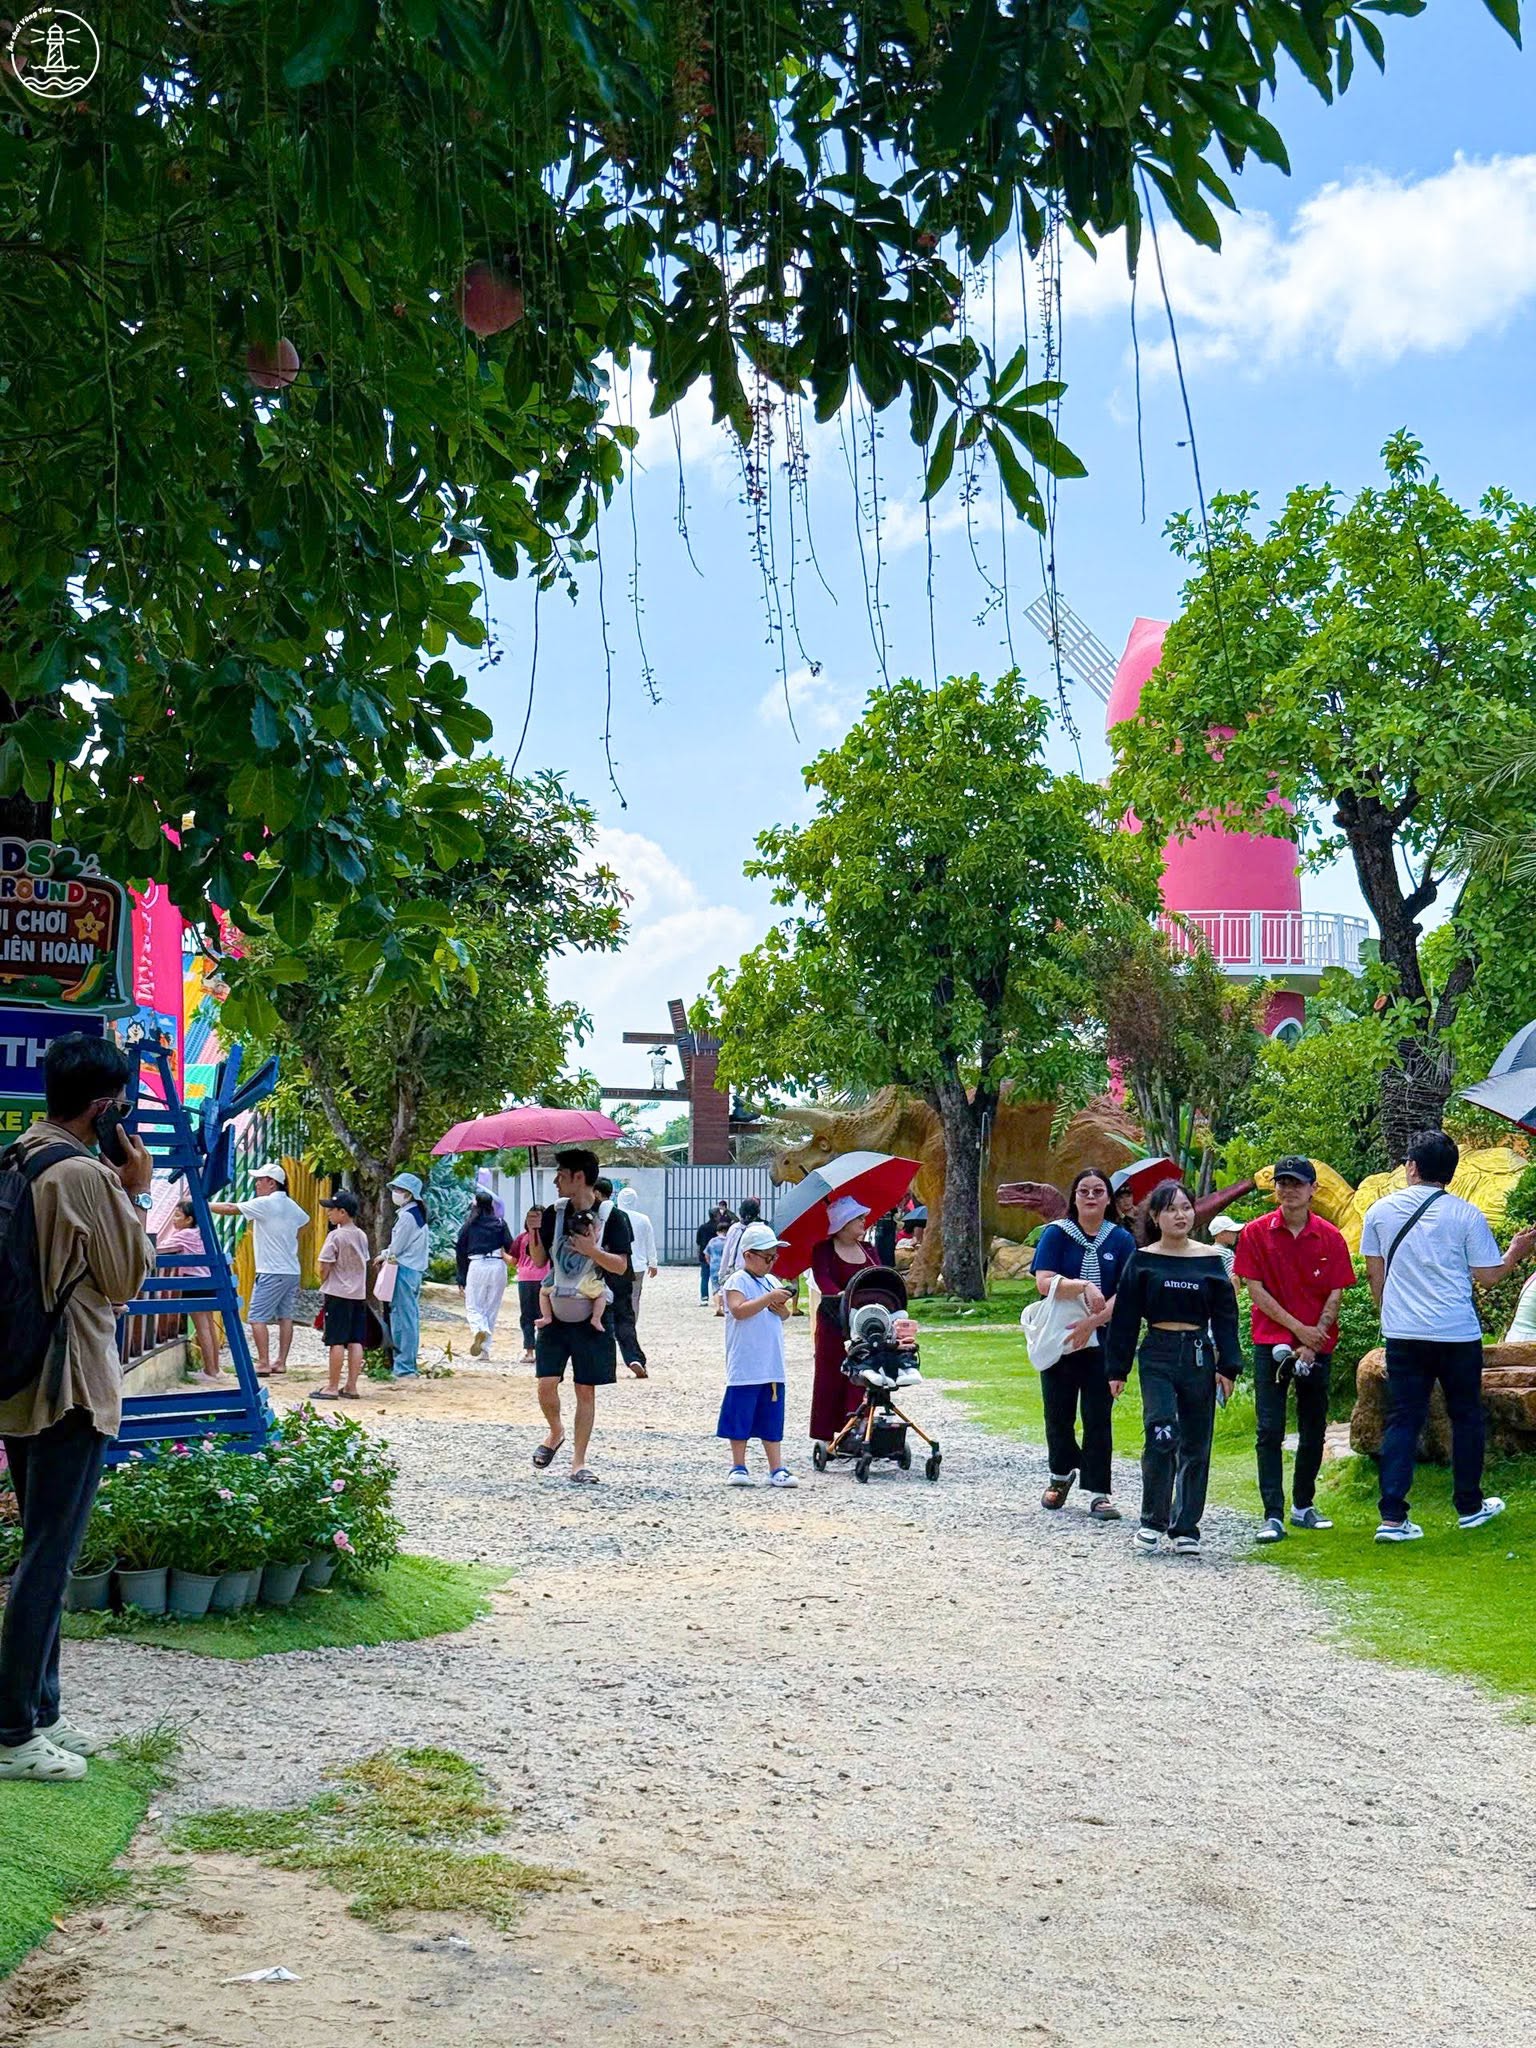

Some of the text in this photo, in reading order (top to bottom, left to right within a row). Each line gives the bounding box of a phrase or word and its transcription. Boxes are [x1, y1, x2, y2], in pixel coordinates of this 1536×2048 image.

[15, 909, 67, 934] CHƠI
[41, 937, 94, 965] HOÀN
[1164, 1280, 1200, 1290] amore
